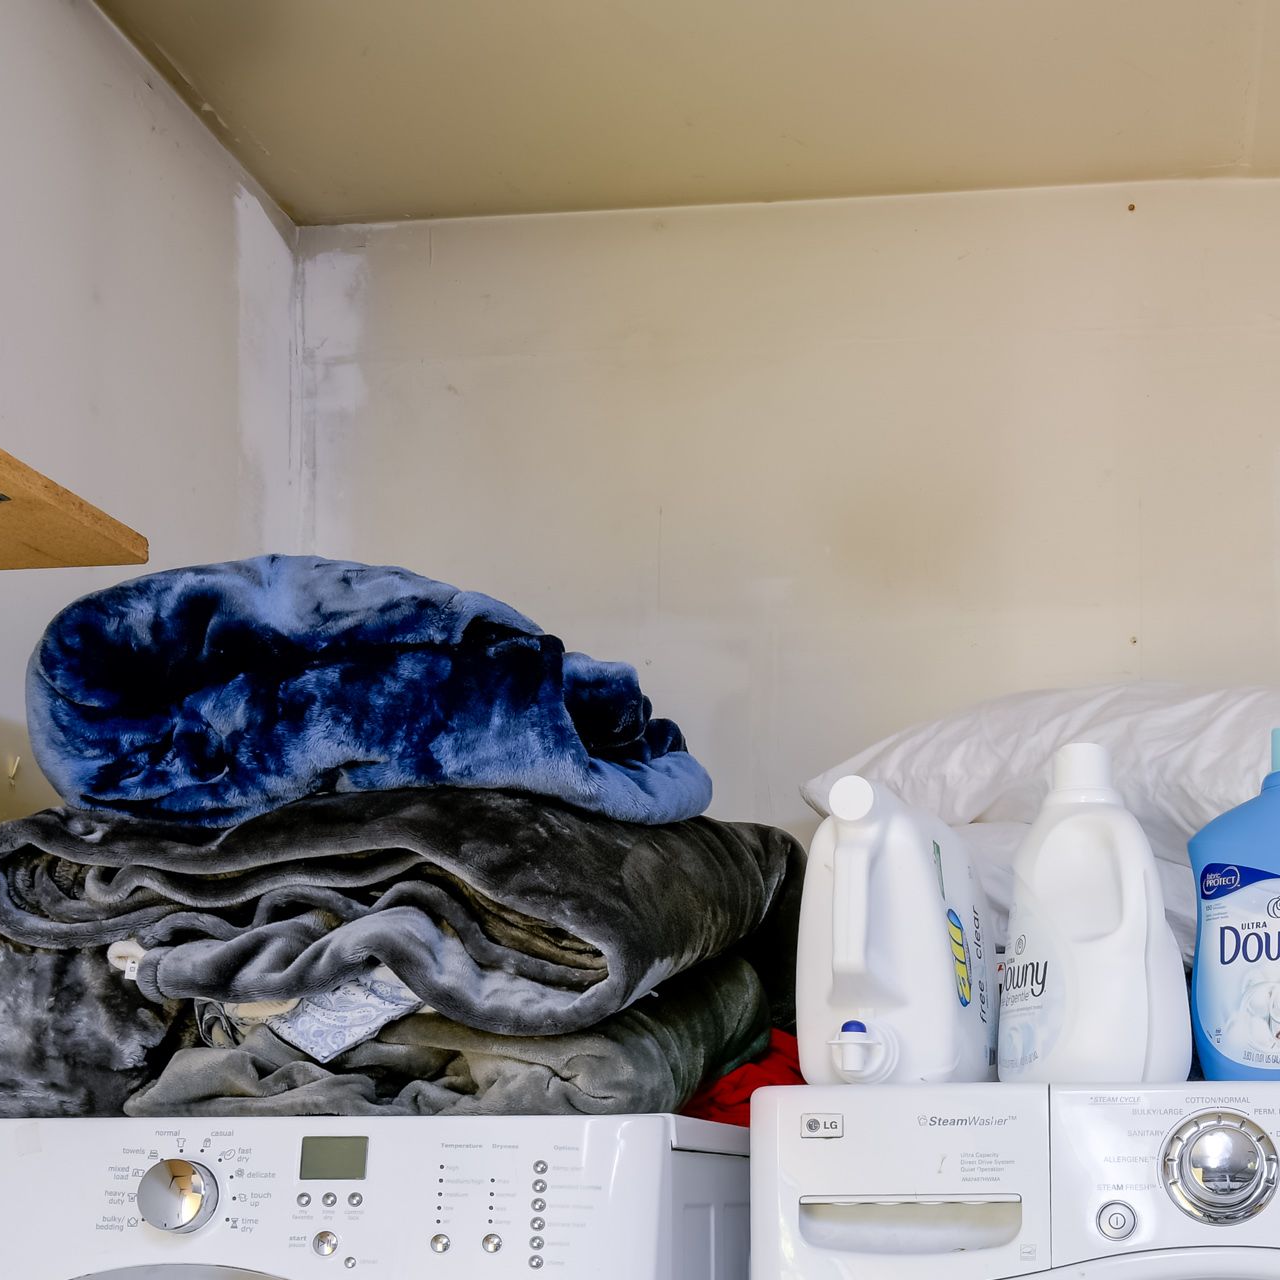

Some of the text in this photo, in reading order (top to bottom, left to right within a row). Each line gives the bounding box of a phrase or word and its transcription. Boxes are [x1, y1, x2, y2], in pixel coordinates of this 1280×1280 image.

[1206, 876, 1235, 887] PROTECT
[1241, 921, 1267, 930] ULTRA
[972, 904, 983, 960] clear
[978, 980, 987, 1024] free
[1185, 1096, 1251, 1104] COTTON/NORMAL
[1132, 1108, 1184, 1116] BULKY/LARGE
[823, 1120, 839, 1130] LG
[154, 1129, 180, 1137] normal
[210, 1129, 234, 1137] casual
[122, 1147, 145, 1155] towels
[238, 1146, 252, 1155] fast
[237, 1154, 250, 1163] dry
[108, 1165, 130, 1173] mixed
[113, 1173, 129, 1181] load
[246, 1171, 276, 1179] delicate
[1096, 1183, 1124, 1191] STEAM
[104, 1189, 126, 1198] heavy
[108, 1197, 125, 1206] duty
[102, 1214, 126, 1223] bulky/
[241, 1217, 259, 1225] time
[95, 1223, 124, 1232] bedding
[240, 1225, 253, 1234] dry
